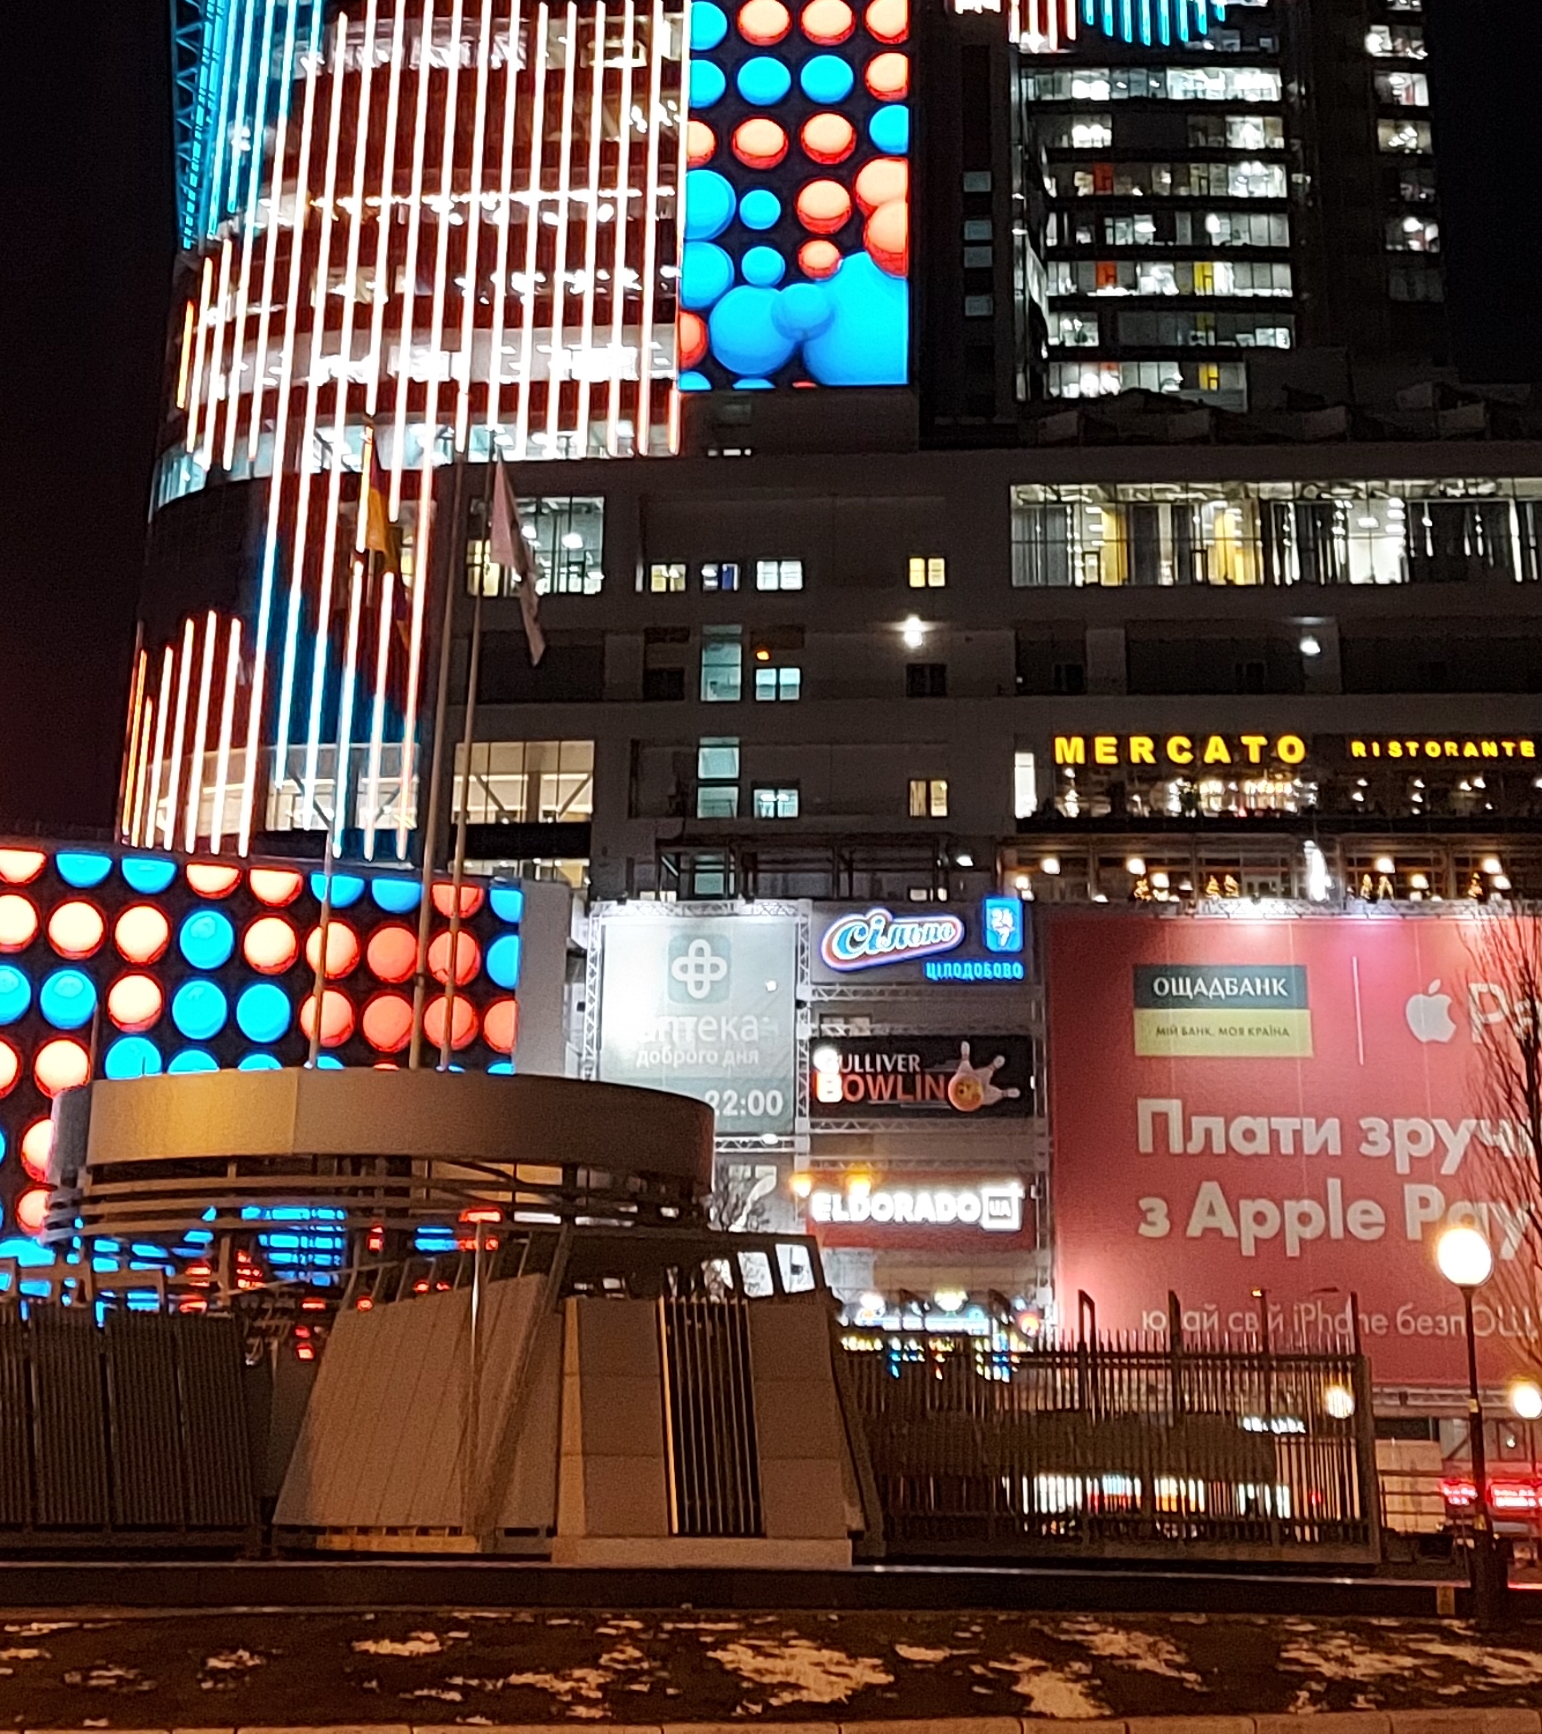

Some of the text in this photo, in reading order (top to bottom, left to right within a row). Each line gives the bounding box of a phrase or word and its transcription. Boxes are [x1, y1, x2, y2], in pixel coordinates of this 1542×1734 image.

[1053, 735, 1537, 765] MERCATO RISTORANTE
[831, 916, 957, 961] Сільпо
[925, 960, 1025, 981] ЦІЛОДОБОВО
[1153, 976, 1289, 1000] ОЩАДБАНК
[1218, 1027, 1246, 1038] МОЯ
[1247, 1024, 1291, 1038] КРАЇНА
[636, 1044, 760, 1068] доброго дня
[814, 1050, 922, 1073] ULLIVER
[1136, 1097, 1342, 1156] Плати
[811, 1192, 982, 1223] ELDORADO
[1137, 1177, 1535, 1261] з Apple Pay
[1141, 1303, 1219, 1332] юай
[1228, 1303, 1284, 1332] свй
[1293, 1302, 1388, 1335] iPhone
